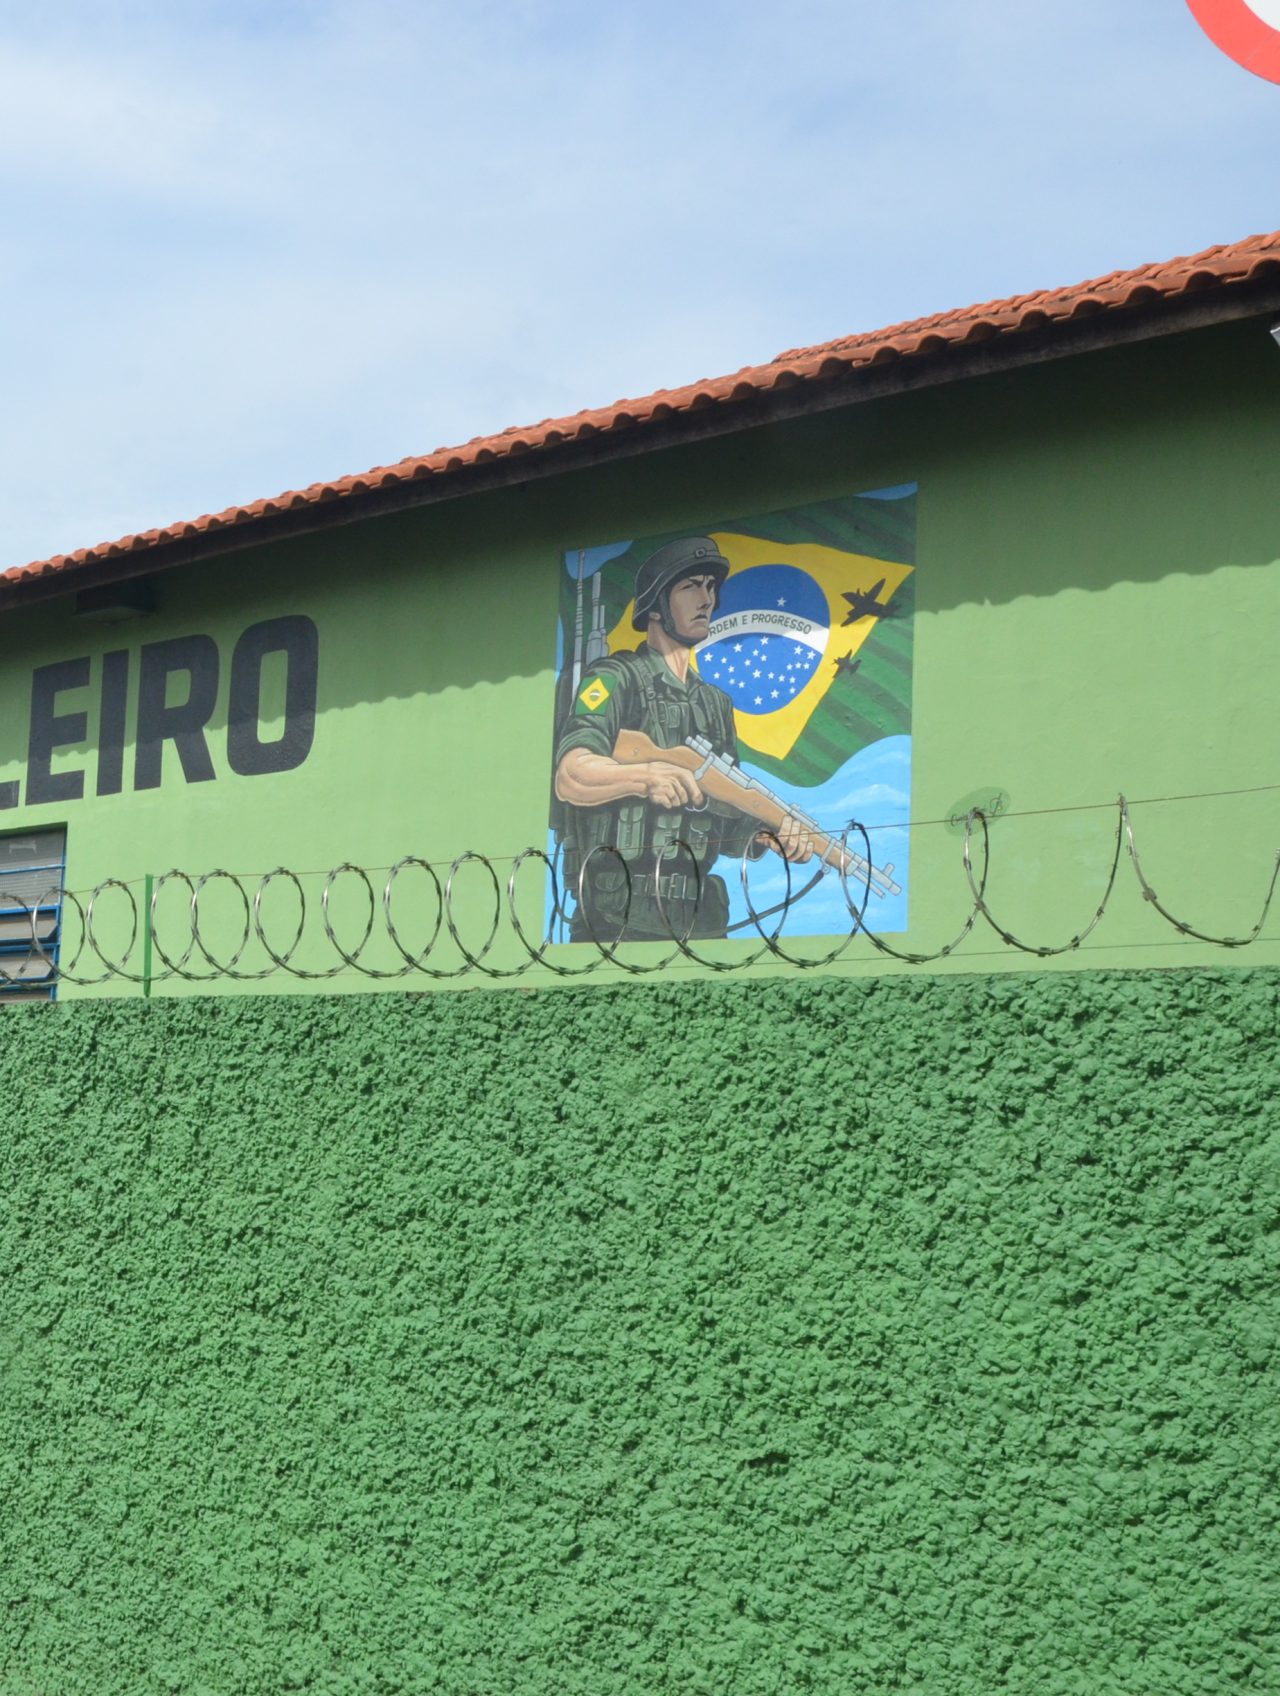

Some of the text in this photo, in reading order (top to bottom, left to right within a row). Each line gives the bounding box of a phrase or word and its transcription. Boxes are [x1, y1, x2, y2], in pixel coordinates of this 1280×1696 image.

[708, 613, 812, 637] RDEM E PROGRESSO
